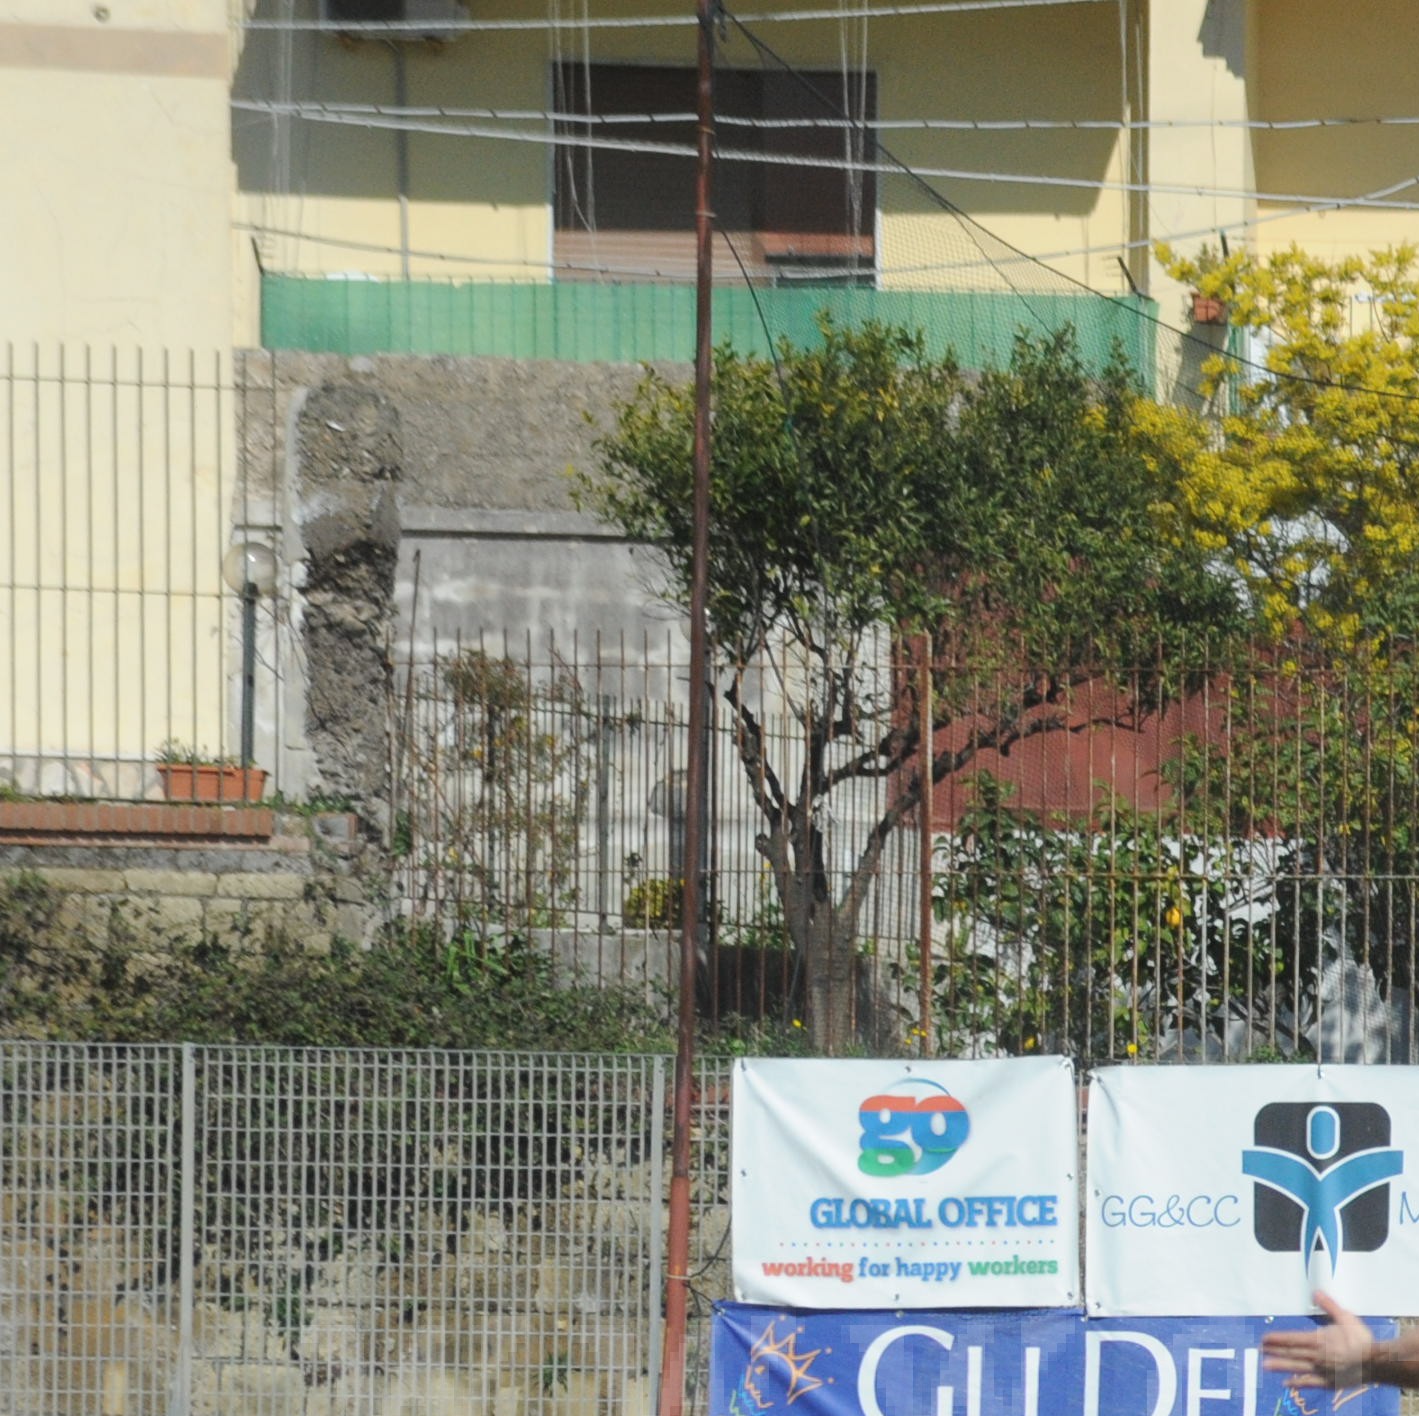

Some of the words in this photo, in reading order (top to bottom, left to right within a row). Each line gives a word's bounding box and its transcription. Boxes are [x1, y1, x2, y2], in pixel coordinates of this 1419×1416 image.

[858, 1094, 970, 1177] go
[809, 1197, 933, 1230] GLOBAL
[937, 1194, 1059, 1228] OFFICE
[1100, 1193, 1242, 1228] GG&CC
[761, 1255, 855, 1284] working
[857, 1256, 890, 1279] for
[894, 1255, 963, 1283] happy
[967, 1254, 1059, 1277] workers
